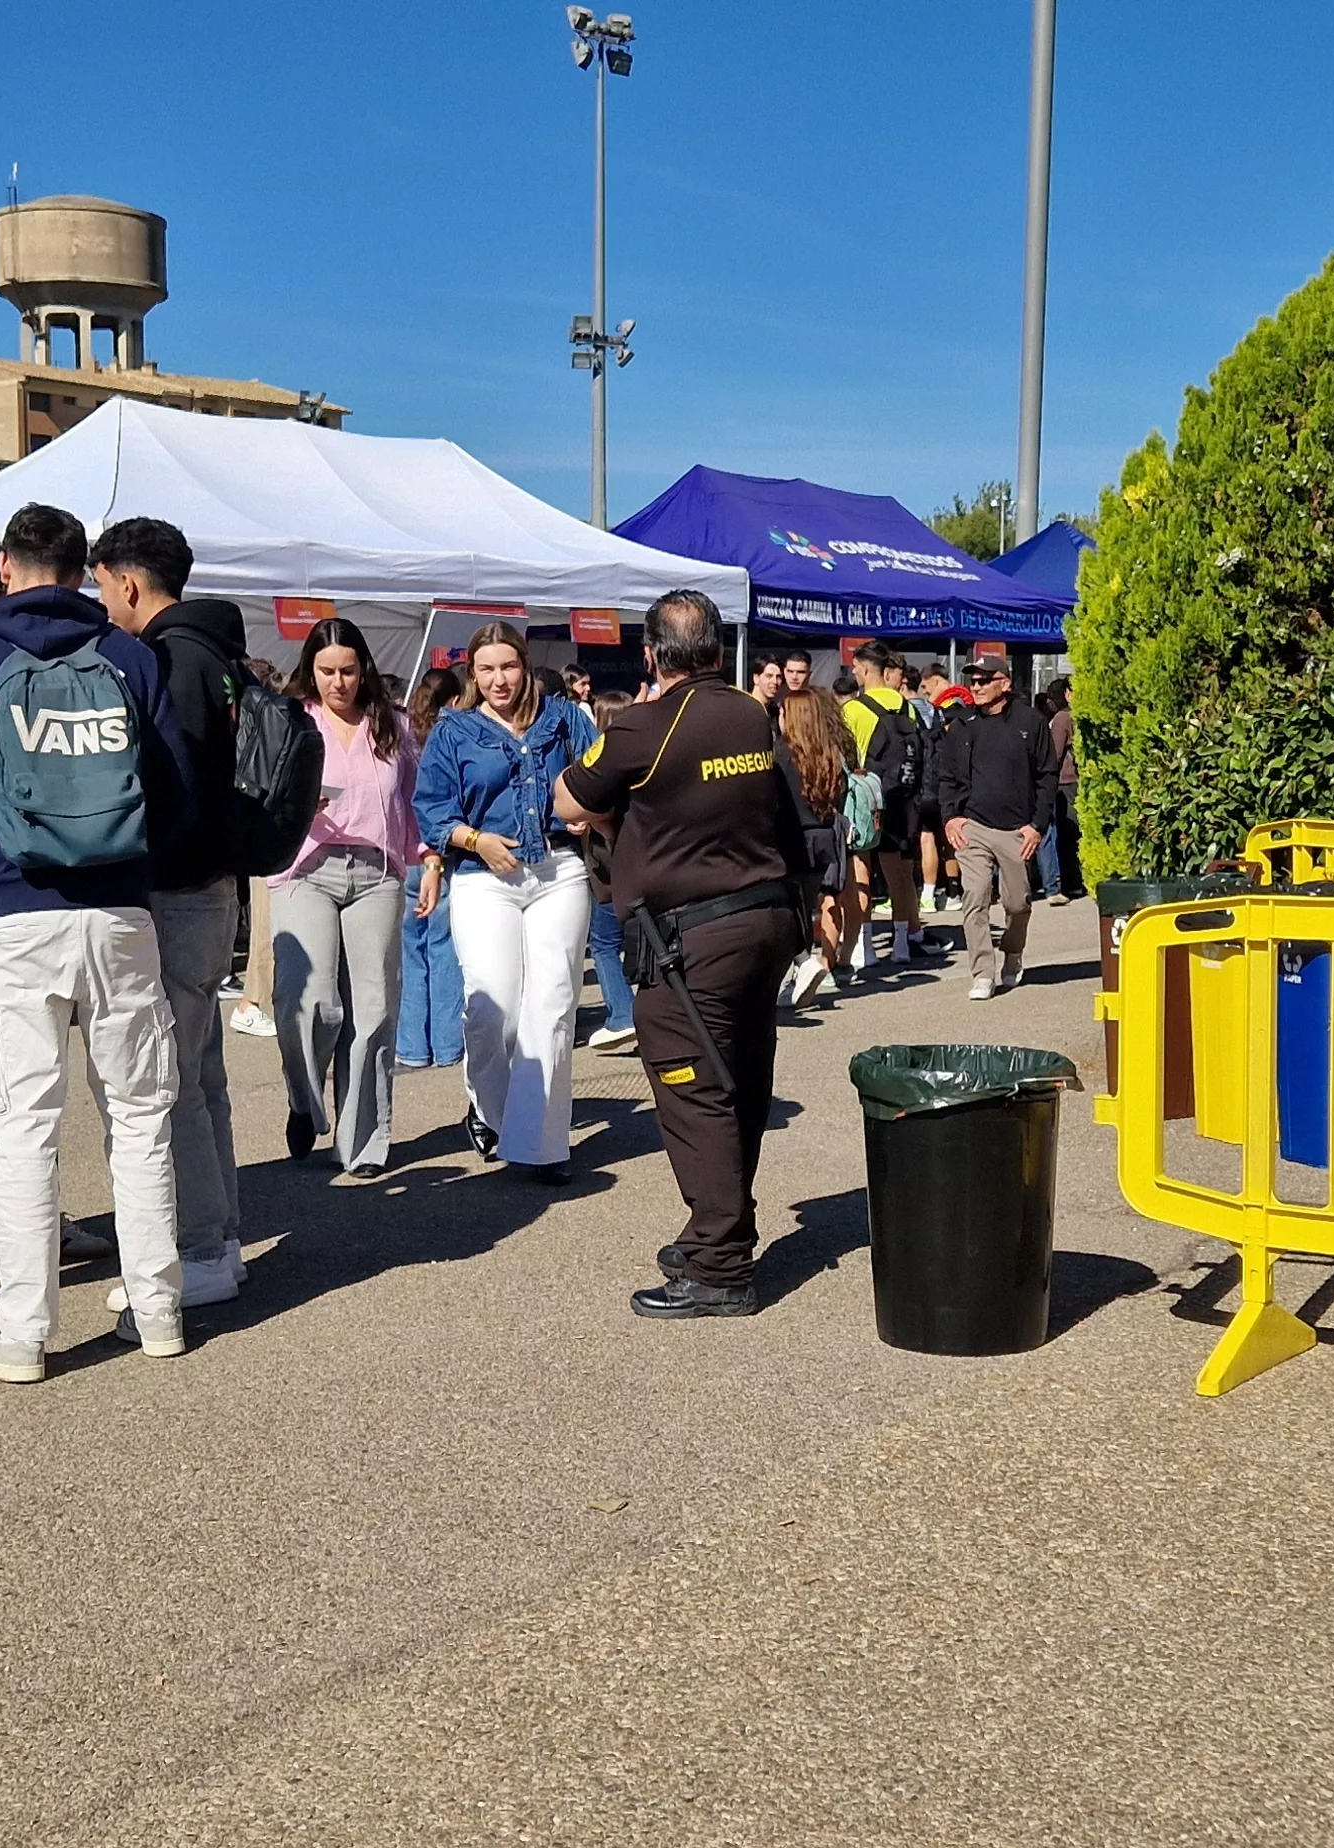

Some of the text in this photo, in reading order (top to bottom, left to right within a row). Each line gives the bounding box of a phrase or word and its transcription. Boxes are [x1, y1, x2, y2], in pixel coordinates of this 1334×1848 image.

[756, 594, 795, 620] UNIZAR
[795, 599, 834, 624] CAMINA
[961, 608, 976, 629] DE
[978, 610, 1052, 634] DESARROLLO
[10, 704, 129, 756] VANS
